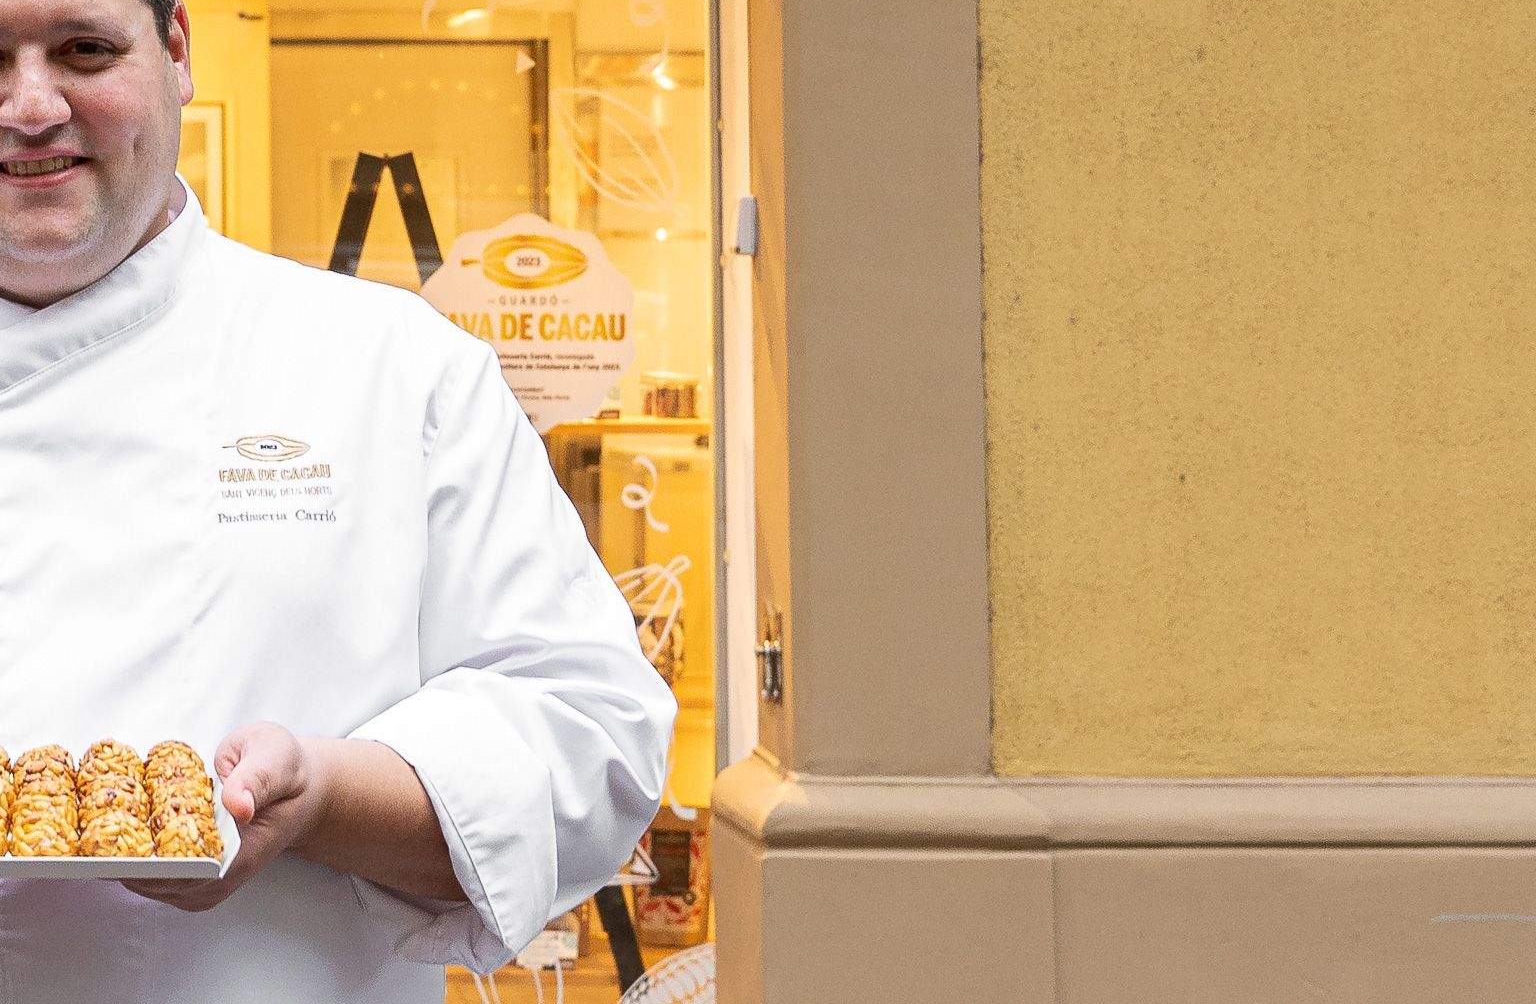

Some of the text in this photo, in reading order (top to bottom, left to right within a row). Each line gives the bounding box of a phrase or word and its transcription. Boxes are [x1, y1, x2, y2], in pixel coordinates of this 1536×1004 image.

[500, 313, 534, 341] DE
[538, 313, 626, 341] CACAU
[218, 463, 332, 483] FAVA DE CACAU
[217, 508, 337, 524] Pastisseria Carrió
